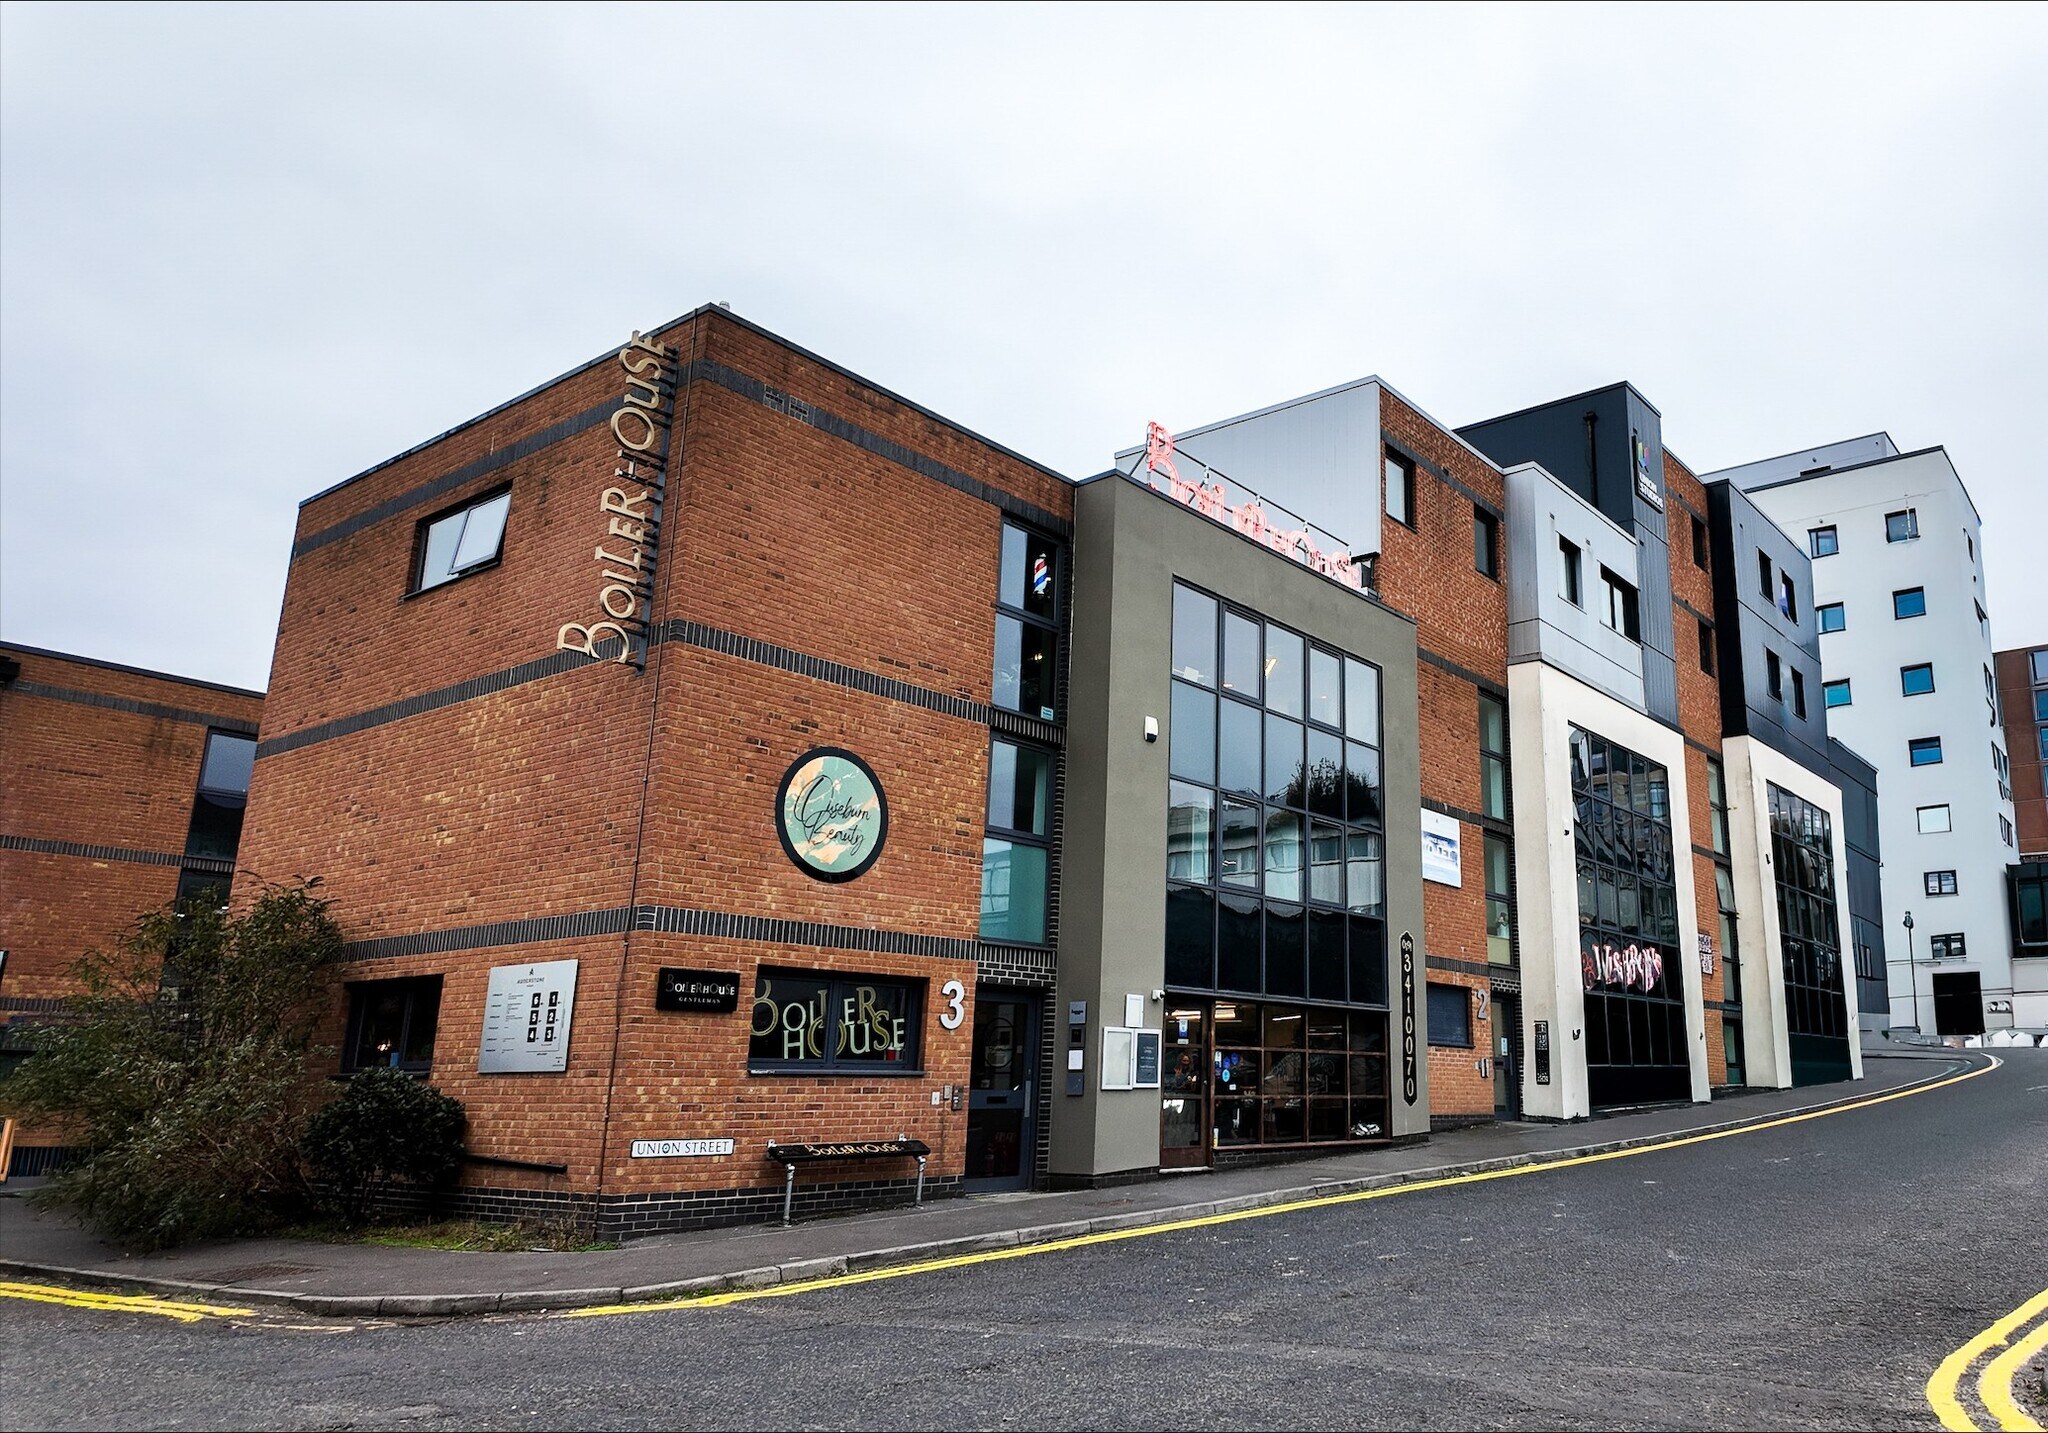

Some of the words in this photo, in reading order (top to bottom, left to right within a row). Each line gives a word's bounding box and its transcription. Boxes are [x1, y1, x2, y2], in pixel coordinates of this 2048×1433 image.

[804, 810, 864, 856] Beauty
[940, 981, 965, 1029] 3
[1477, 988, 1488, 1019] 2
[637, 1142, 680, 1155] UNION
[685, 1141, 729, 1153] STREET
